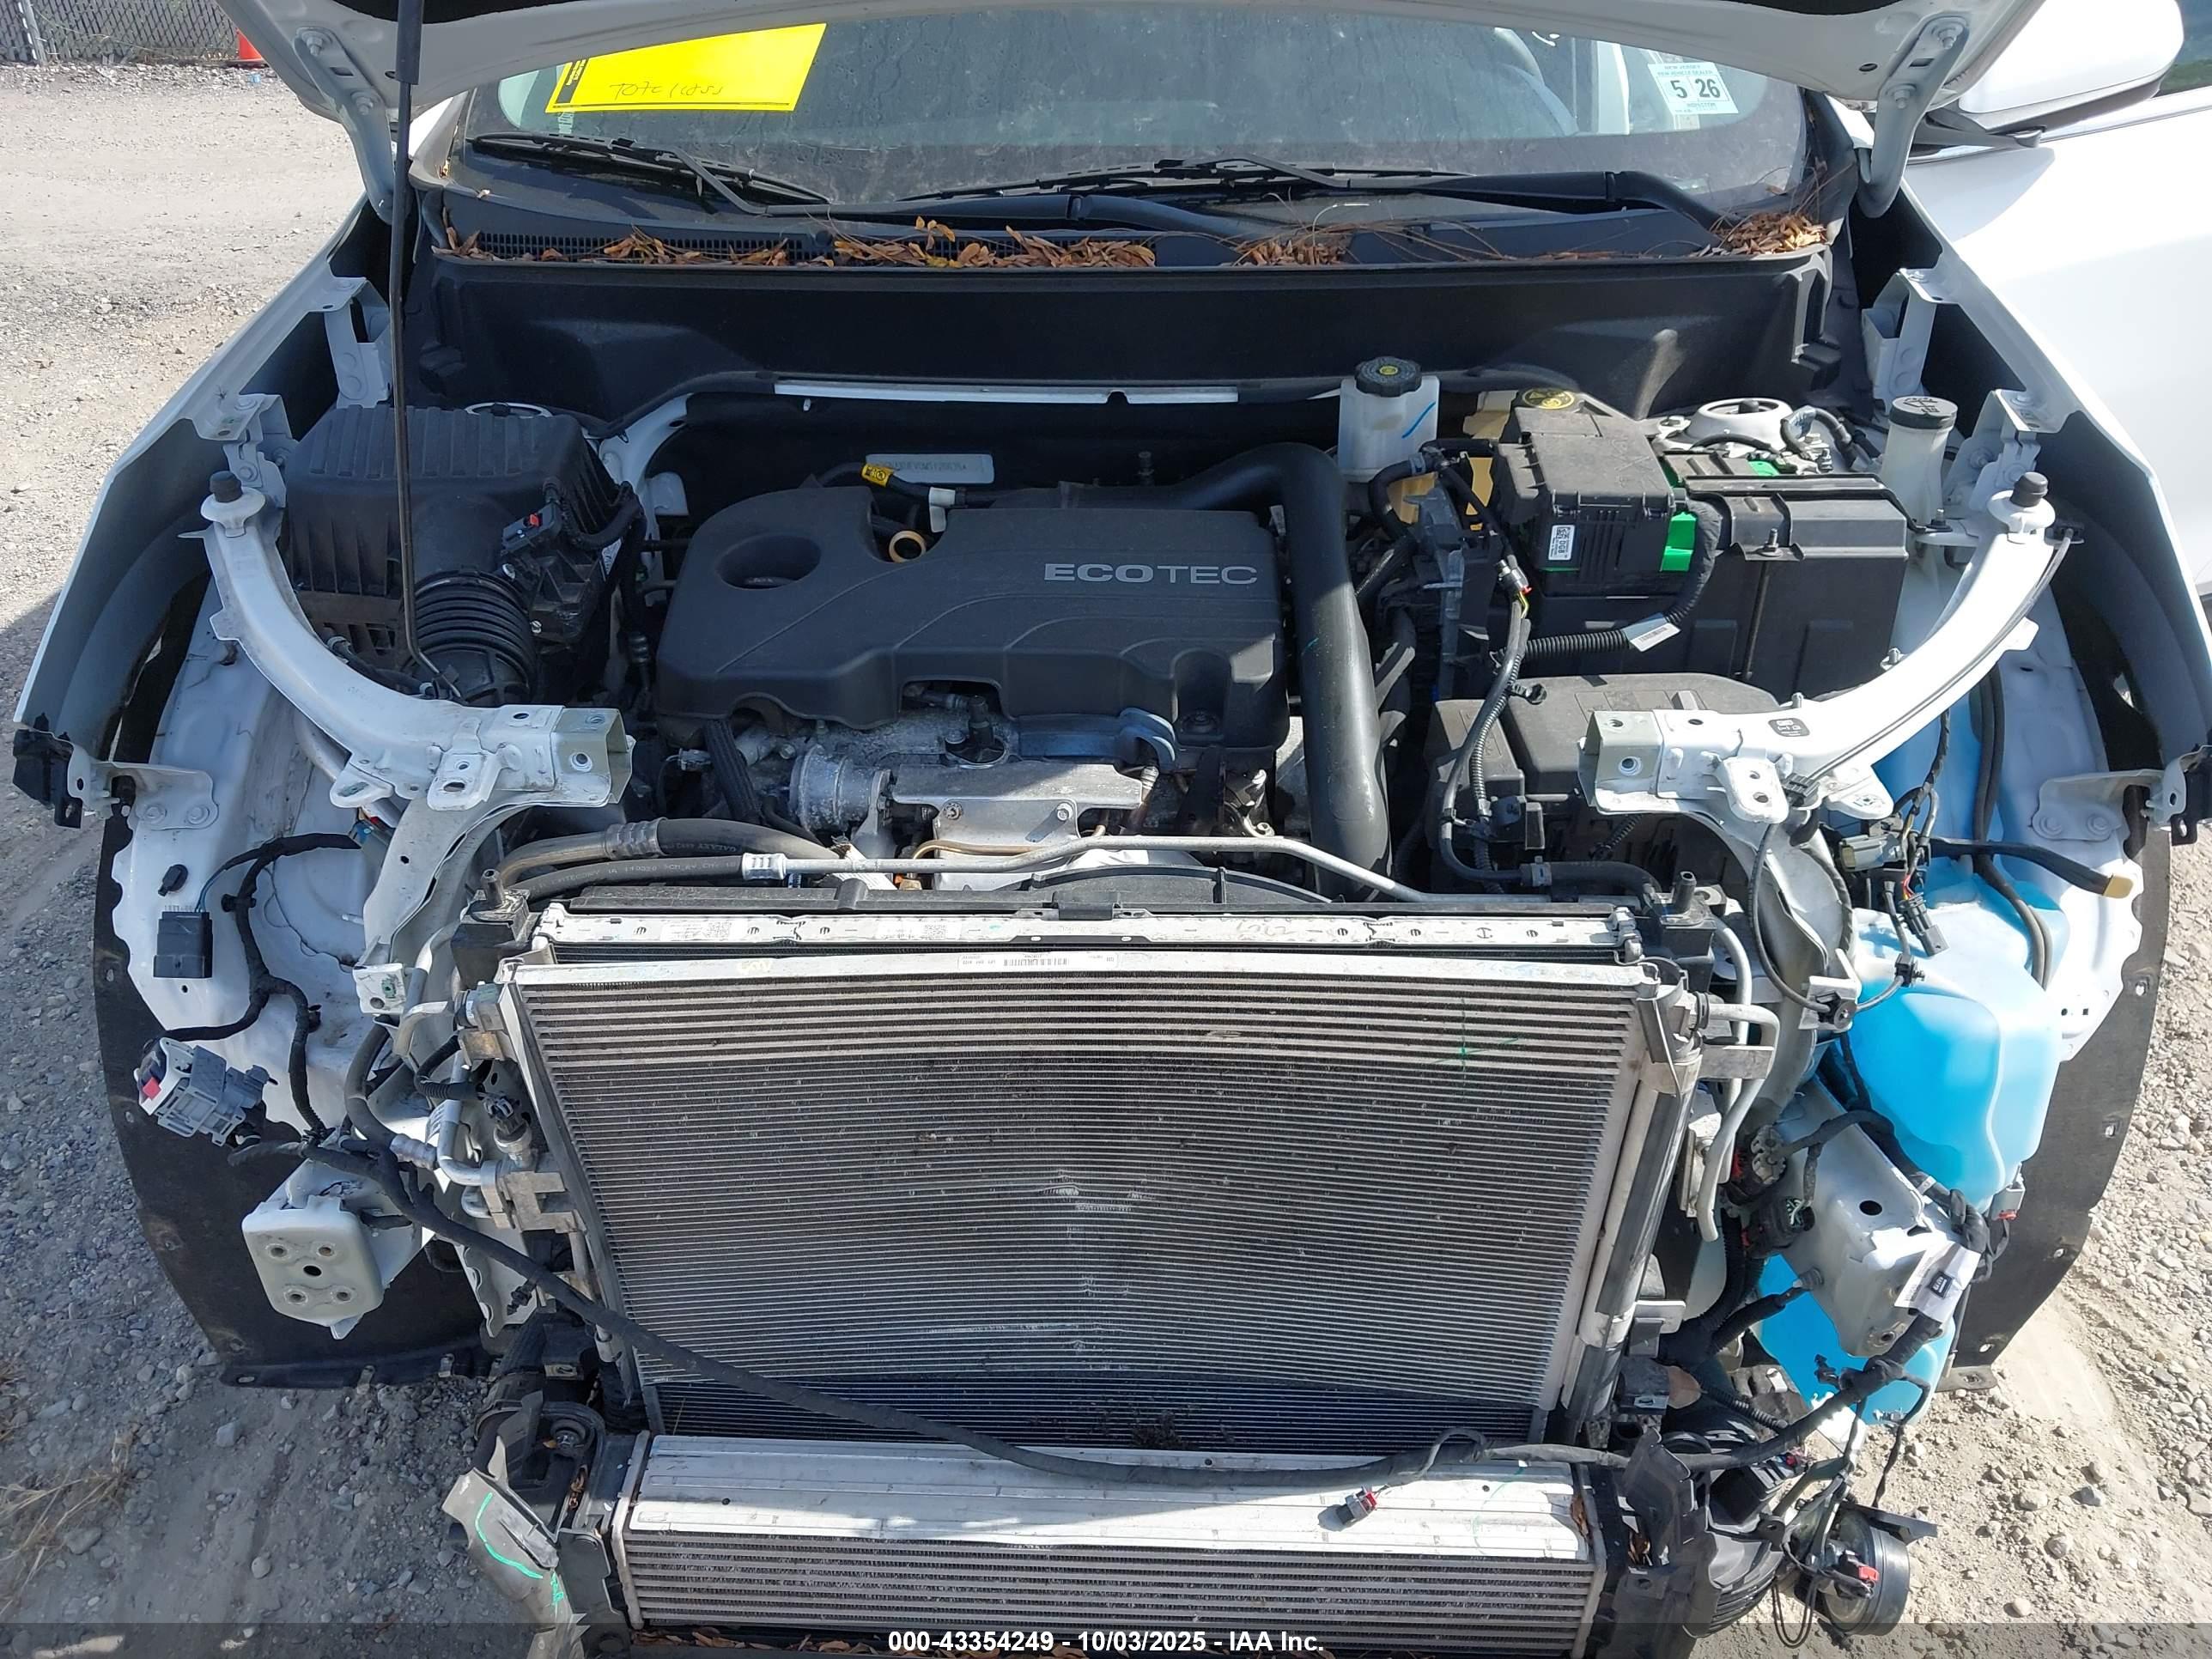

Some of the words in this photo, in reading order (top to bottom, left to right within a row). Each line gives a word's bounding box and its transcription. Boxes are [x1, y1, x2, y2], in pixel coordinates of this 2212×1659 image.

[1670, 80, 1688, 99] 5
[1694, 77, 1722, 98] 26
[1043, 563, 1257, 585] ECOTEC
